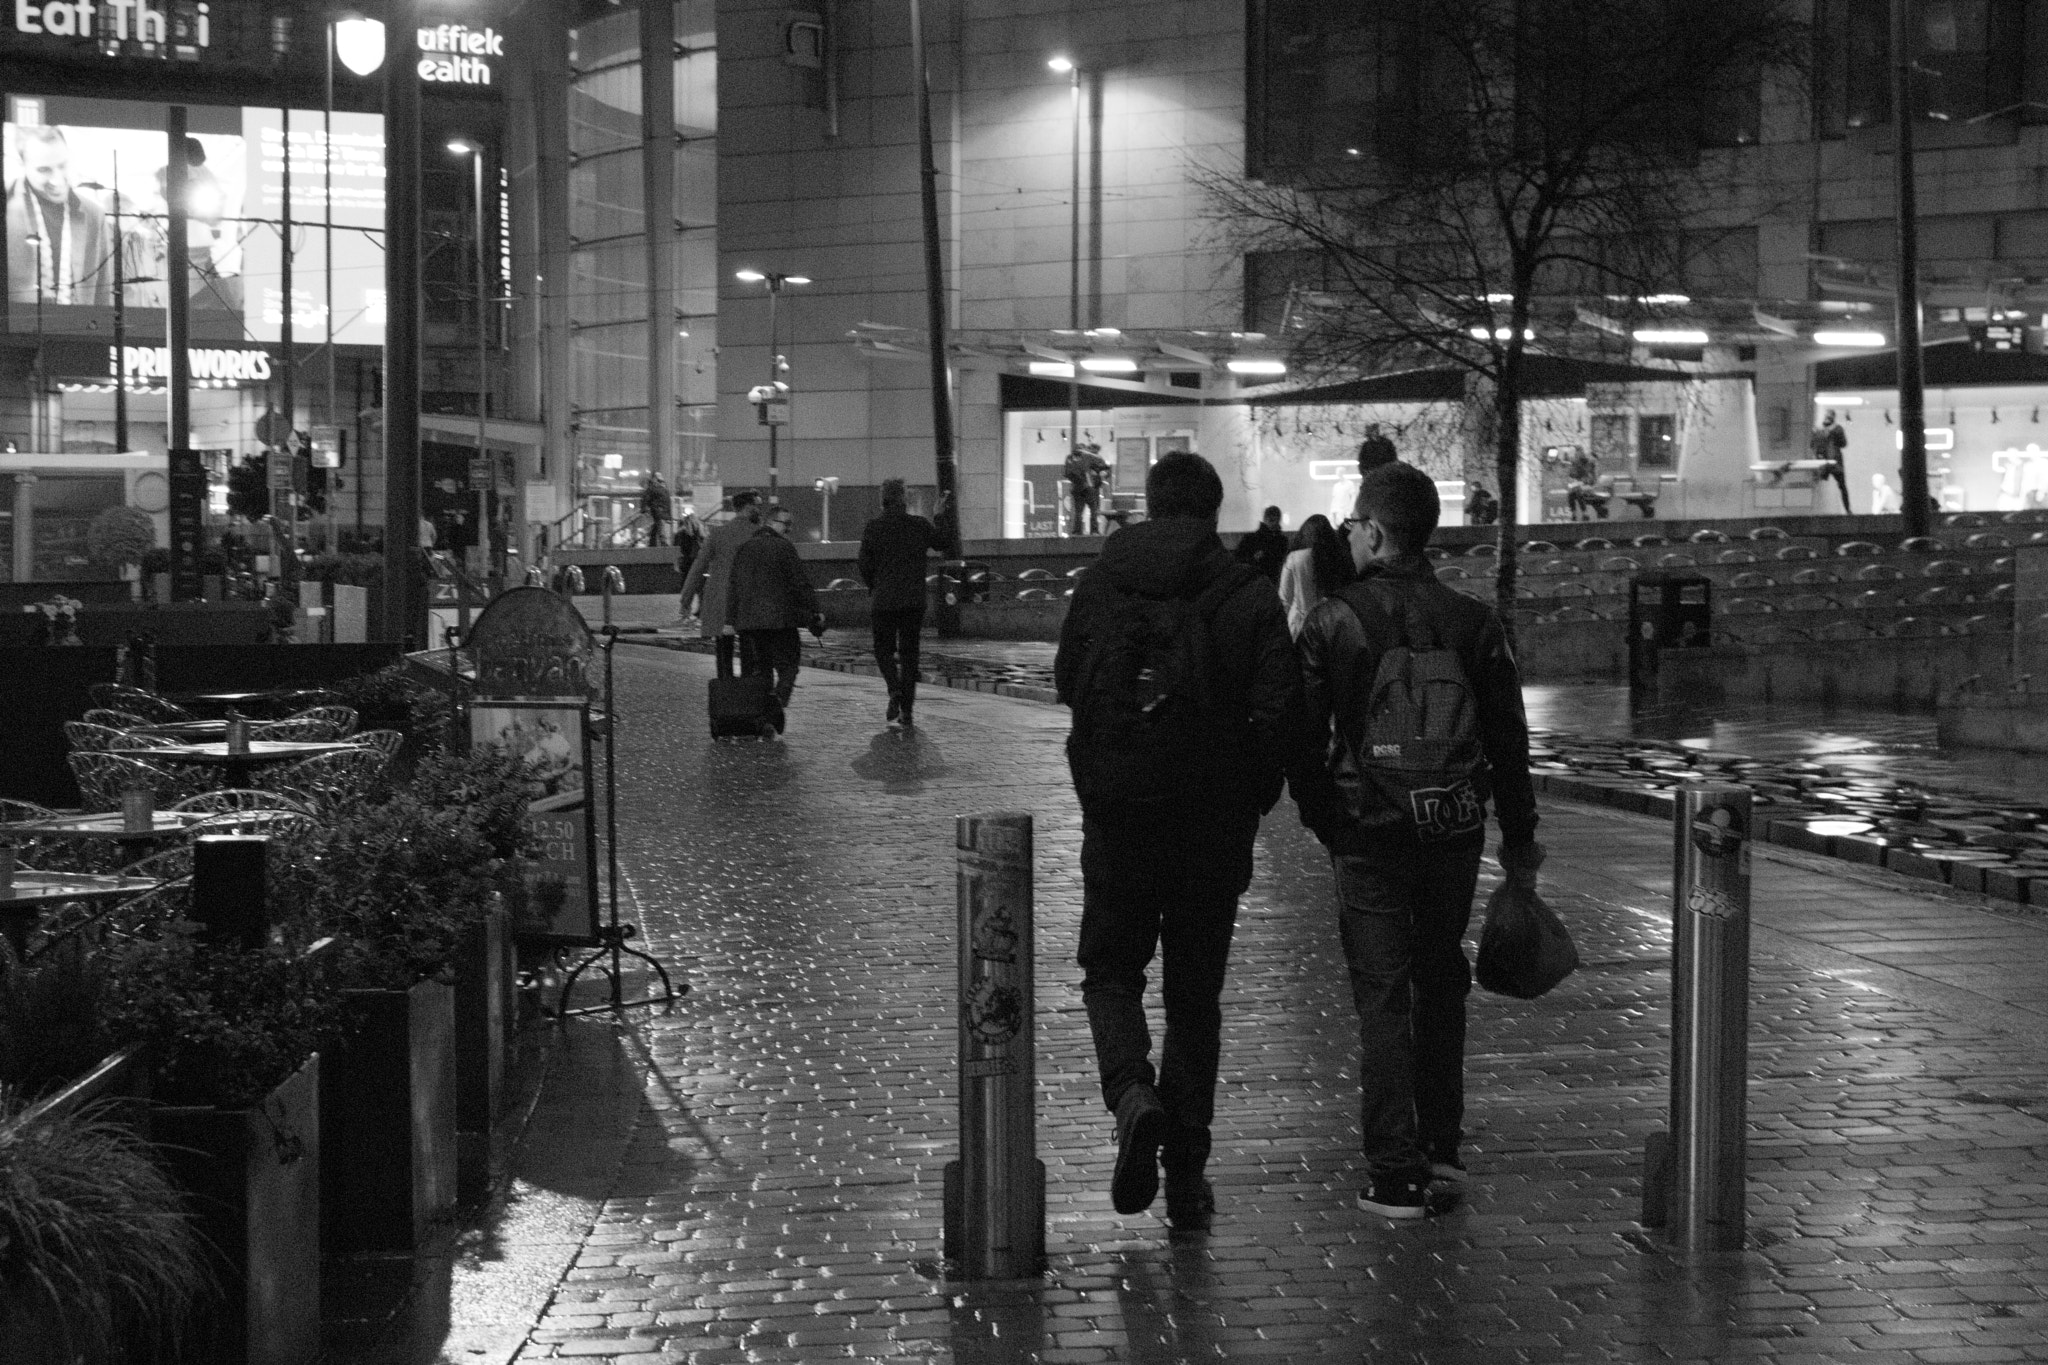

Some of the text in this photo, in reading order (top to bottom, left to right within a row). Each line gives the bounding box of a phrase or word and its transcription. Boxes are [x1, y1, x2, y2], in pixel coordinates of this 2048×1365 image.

[16, 0, 210, 48] Eat Thi
[417, 55, 491, 85] ealth
[123, 345, 272, 380] PRIWORKS
